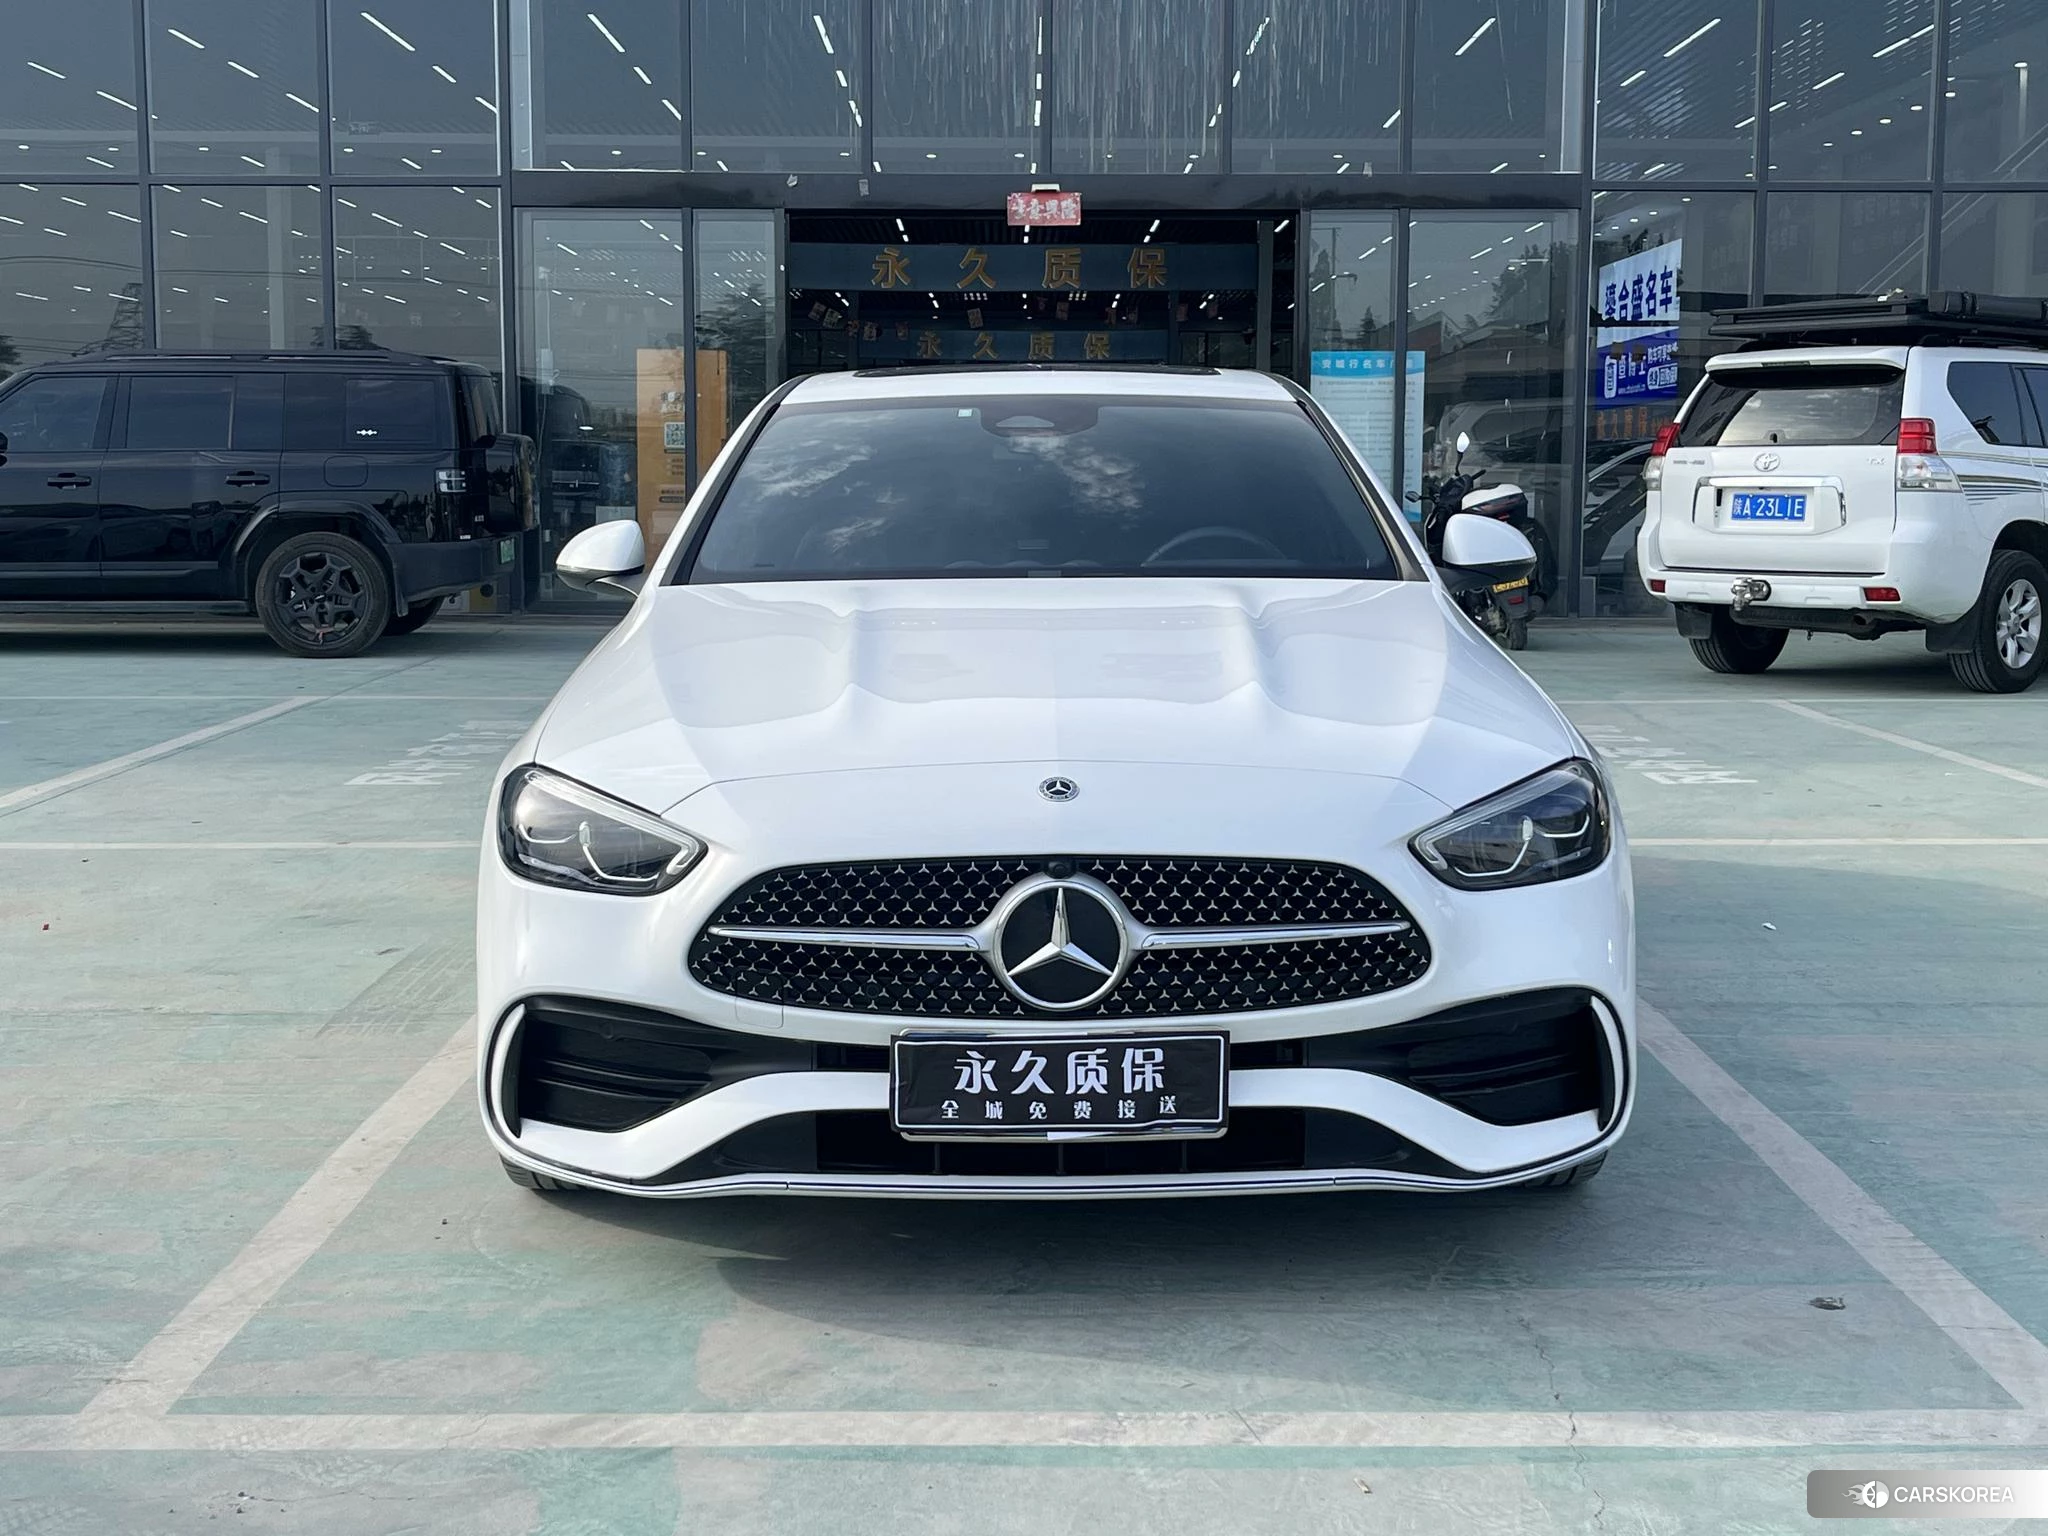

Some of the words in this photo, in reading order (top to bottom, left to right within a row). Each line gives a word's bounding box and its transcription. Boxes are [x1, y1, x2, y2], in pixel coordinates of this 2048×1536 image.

[871, 248, 1167, 289] 永久质保
[916, 332, 1111, 360] 永久质保
[954, 1048, 1165, 1094] 永久质保
[941, 1095, 1177, 1119] 全城免费接送
